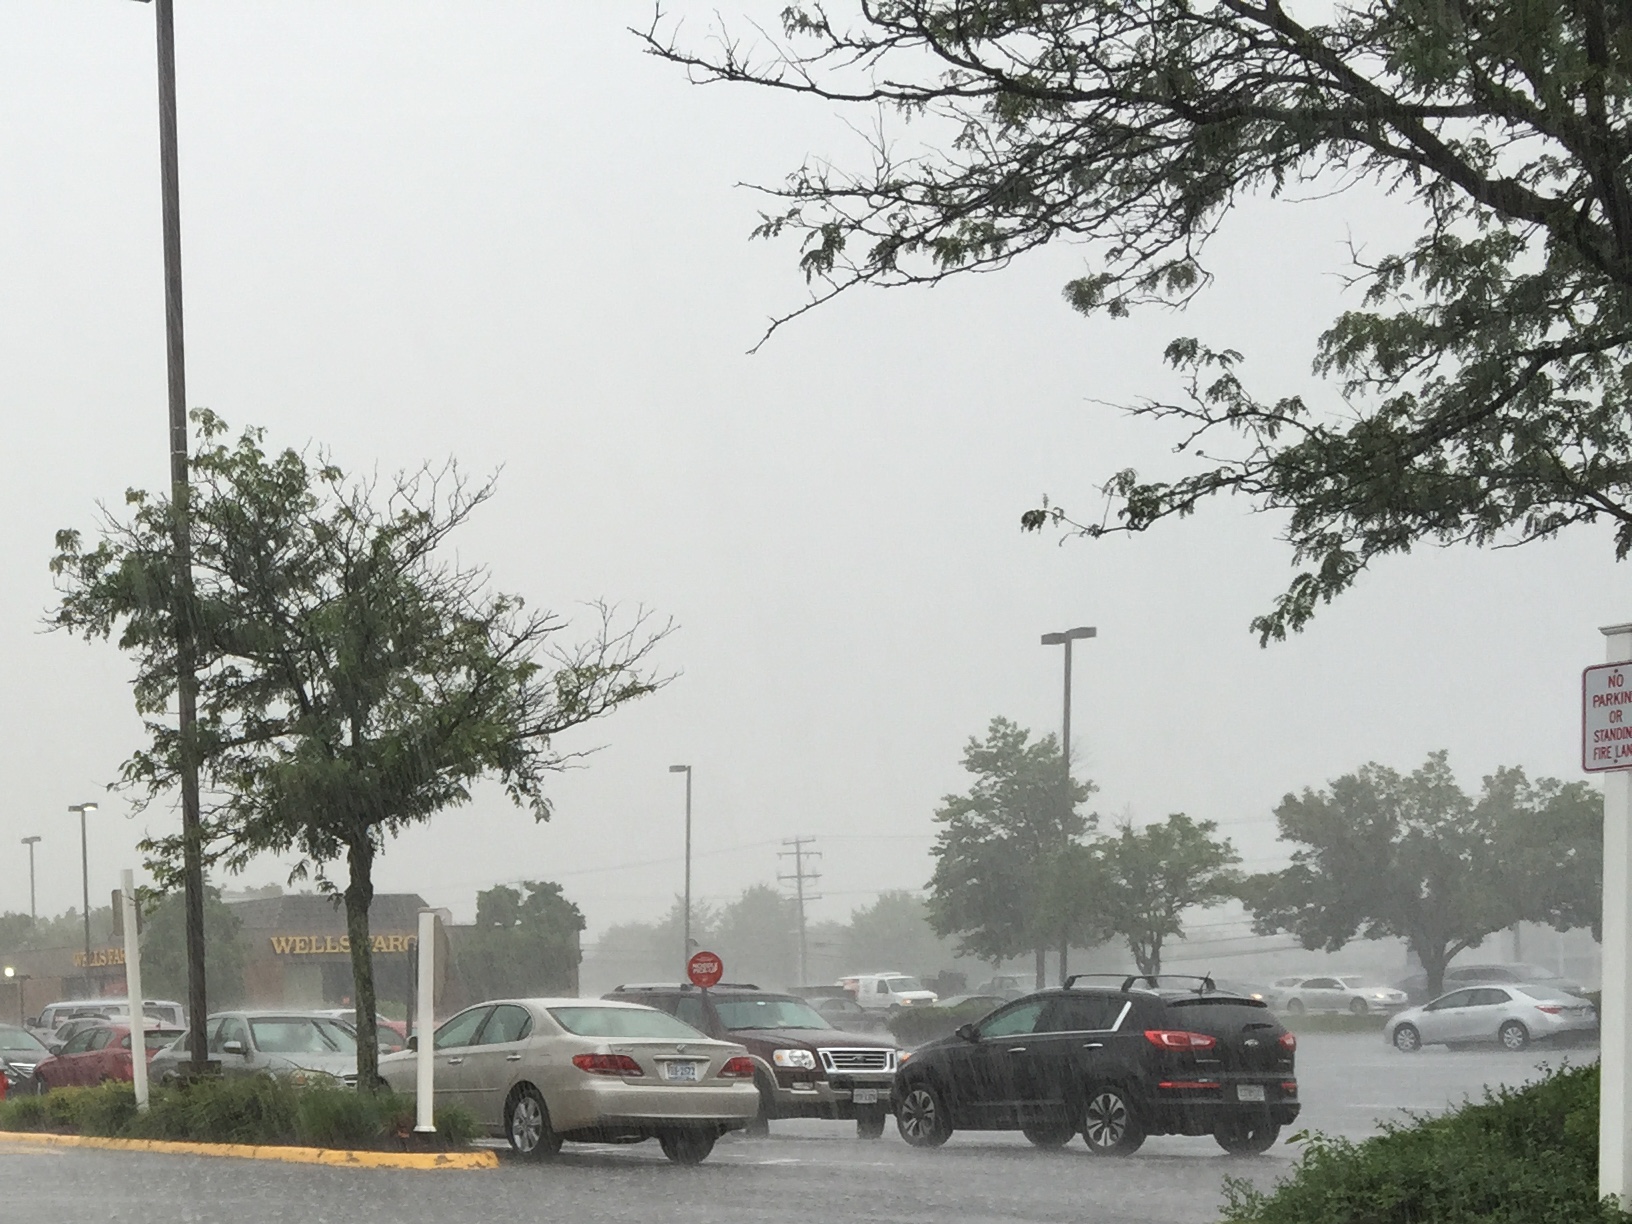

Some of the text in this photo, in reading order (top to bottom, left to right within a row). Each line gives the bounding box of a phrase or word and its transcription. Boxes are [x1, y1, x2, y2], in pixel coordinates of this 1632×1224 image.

[1608, 674, 1624, 688] NO
[1593, 691, 1632, 708] PARKIN
[1609, 709, 1623, 723] OR
[1594, 727, 1632, 743] STANDIN
[1593, 744, 1632, 760] FIRE LAN
[270, 935, 351, 954] WELLS
